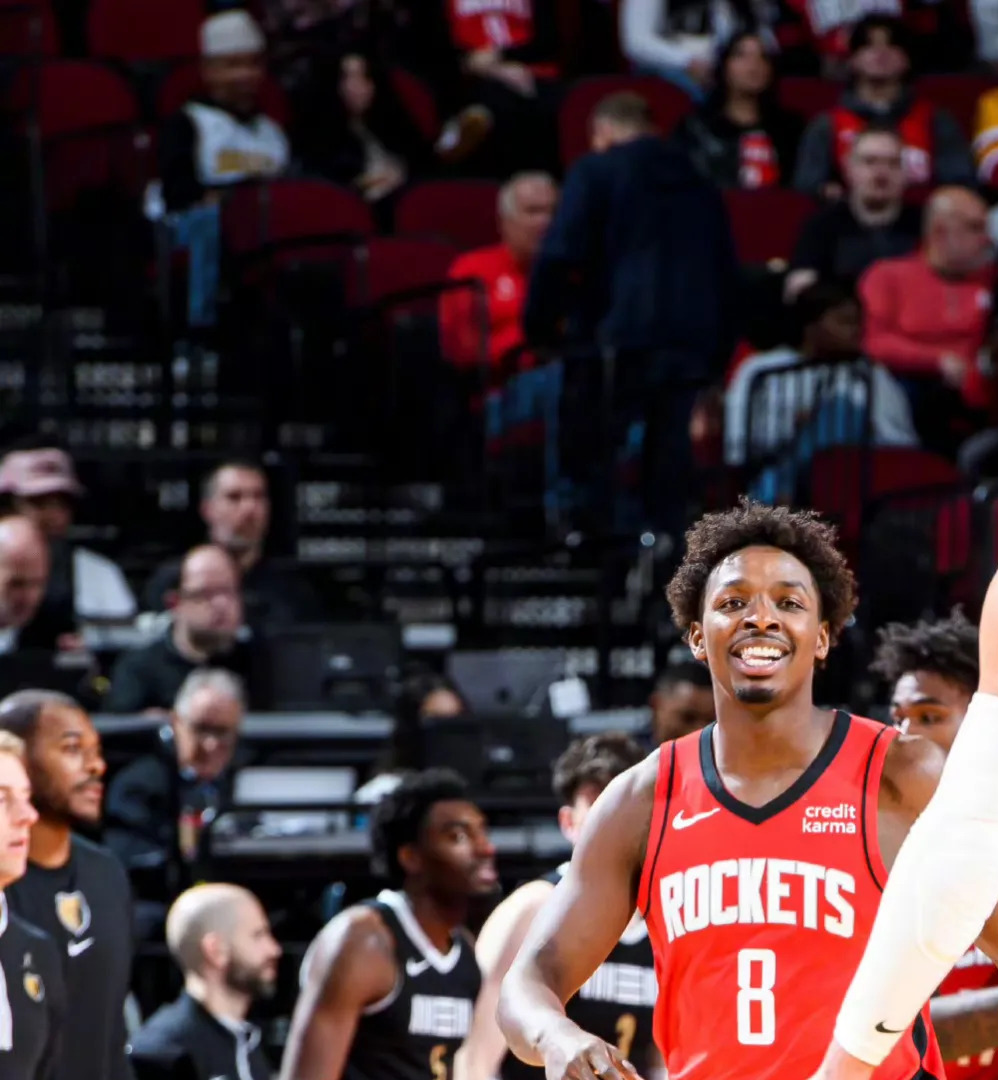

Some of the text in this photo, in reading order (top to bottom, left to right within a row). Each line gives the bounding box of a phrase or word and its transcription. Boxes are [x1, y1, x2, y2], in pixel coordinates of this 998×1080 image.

[802, 819, 857, 834] karma
[805, 804, 856, 819] credit
[659, 857, 856, 944] ROCKETS
[736, 948, 777, 1046] 8
